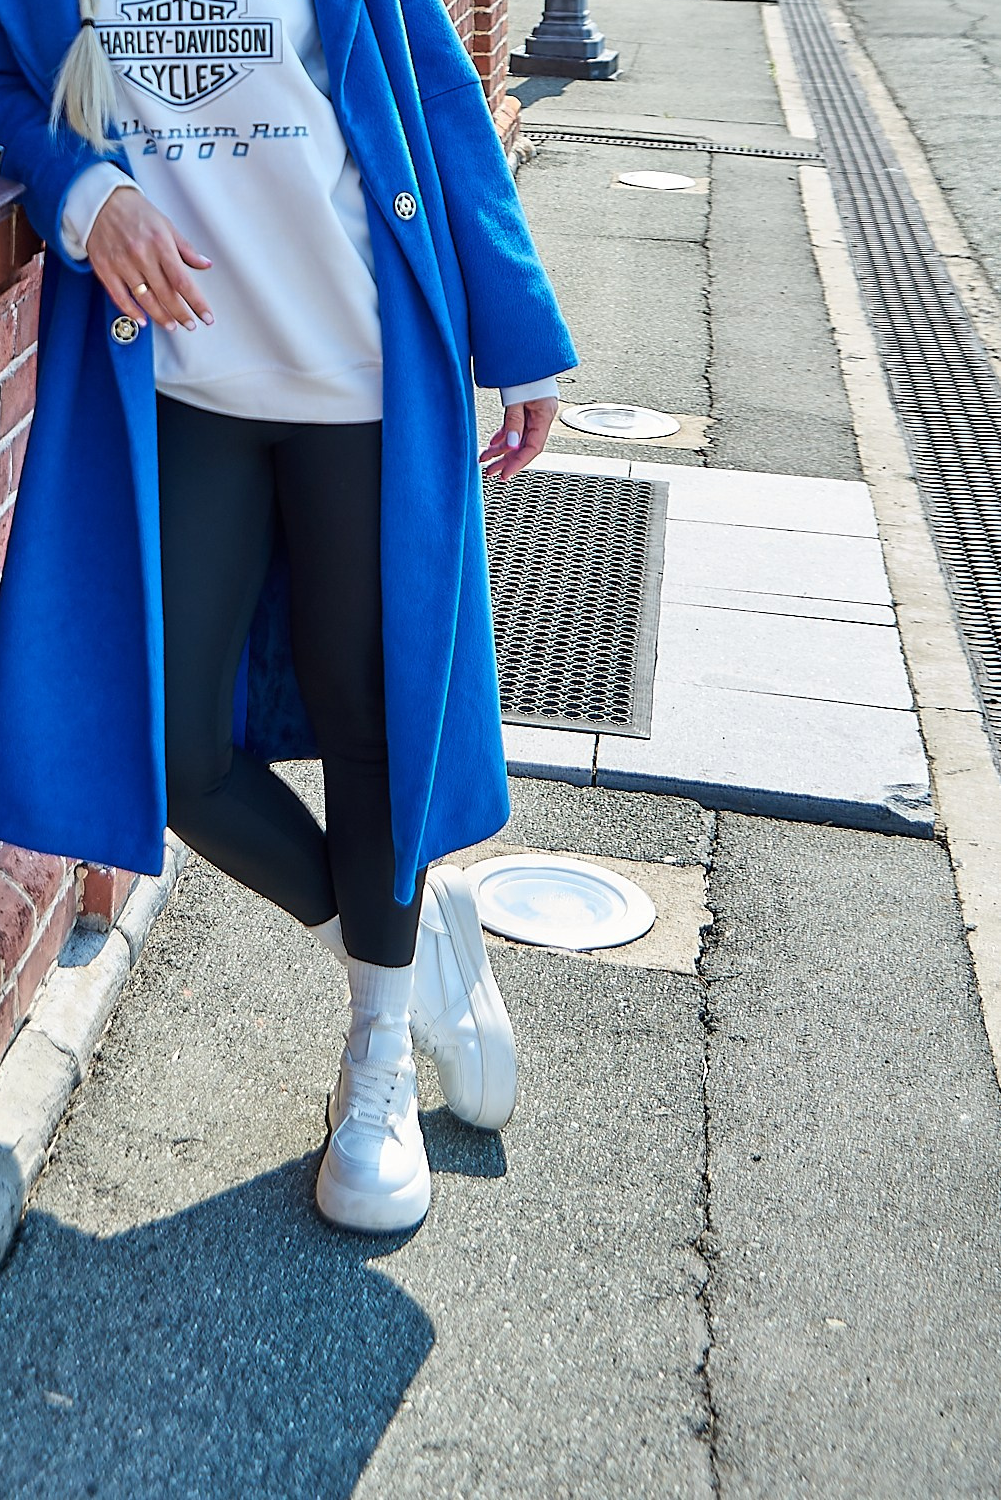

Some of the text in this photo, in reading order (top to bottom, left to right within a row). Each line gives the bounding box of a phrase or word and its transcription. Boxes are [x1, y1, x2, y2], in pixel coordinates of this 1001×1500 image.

[100, 27, 267, 55] HARLEY-DAVIDSON
[140, 63, 225, 100] CYCLES
[120, 118, 310, 141] llnnium Run
